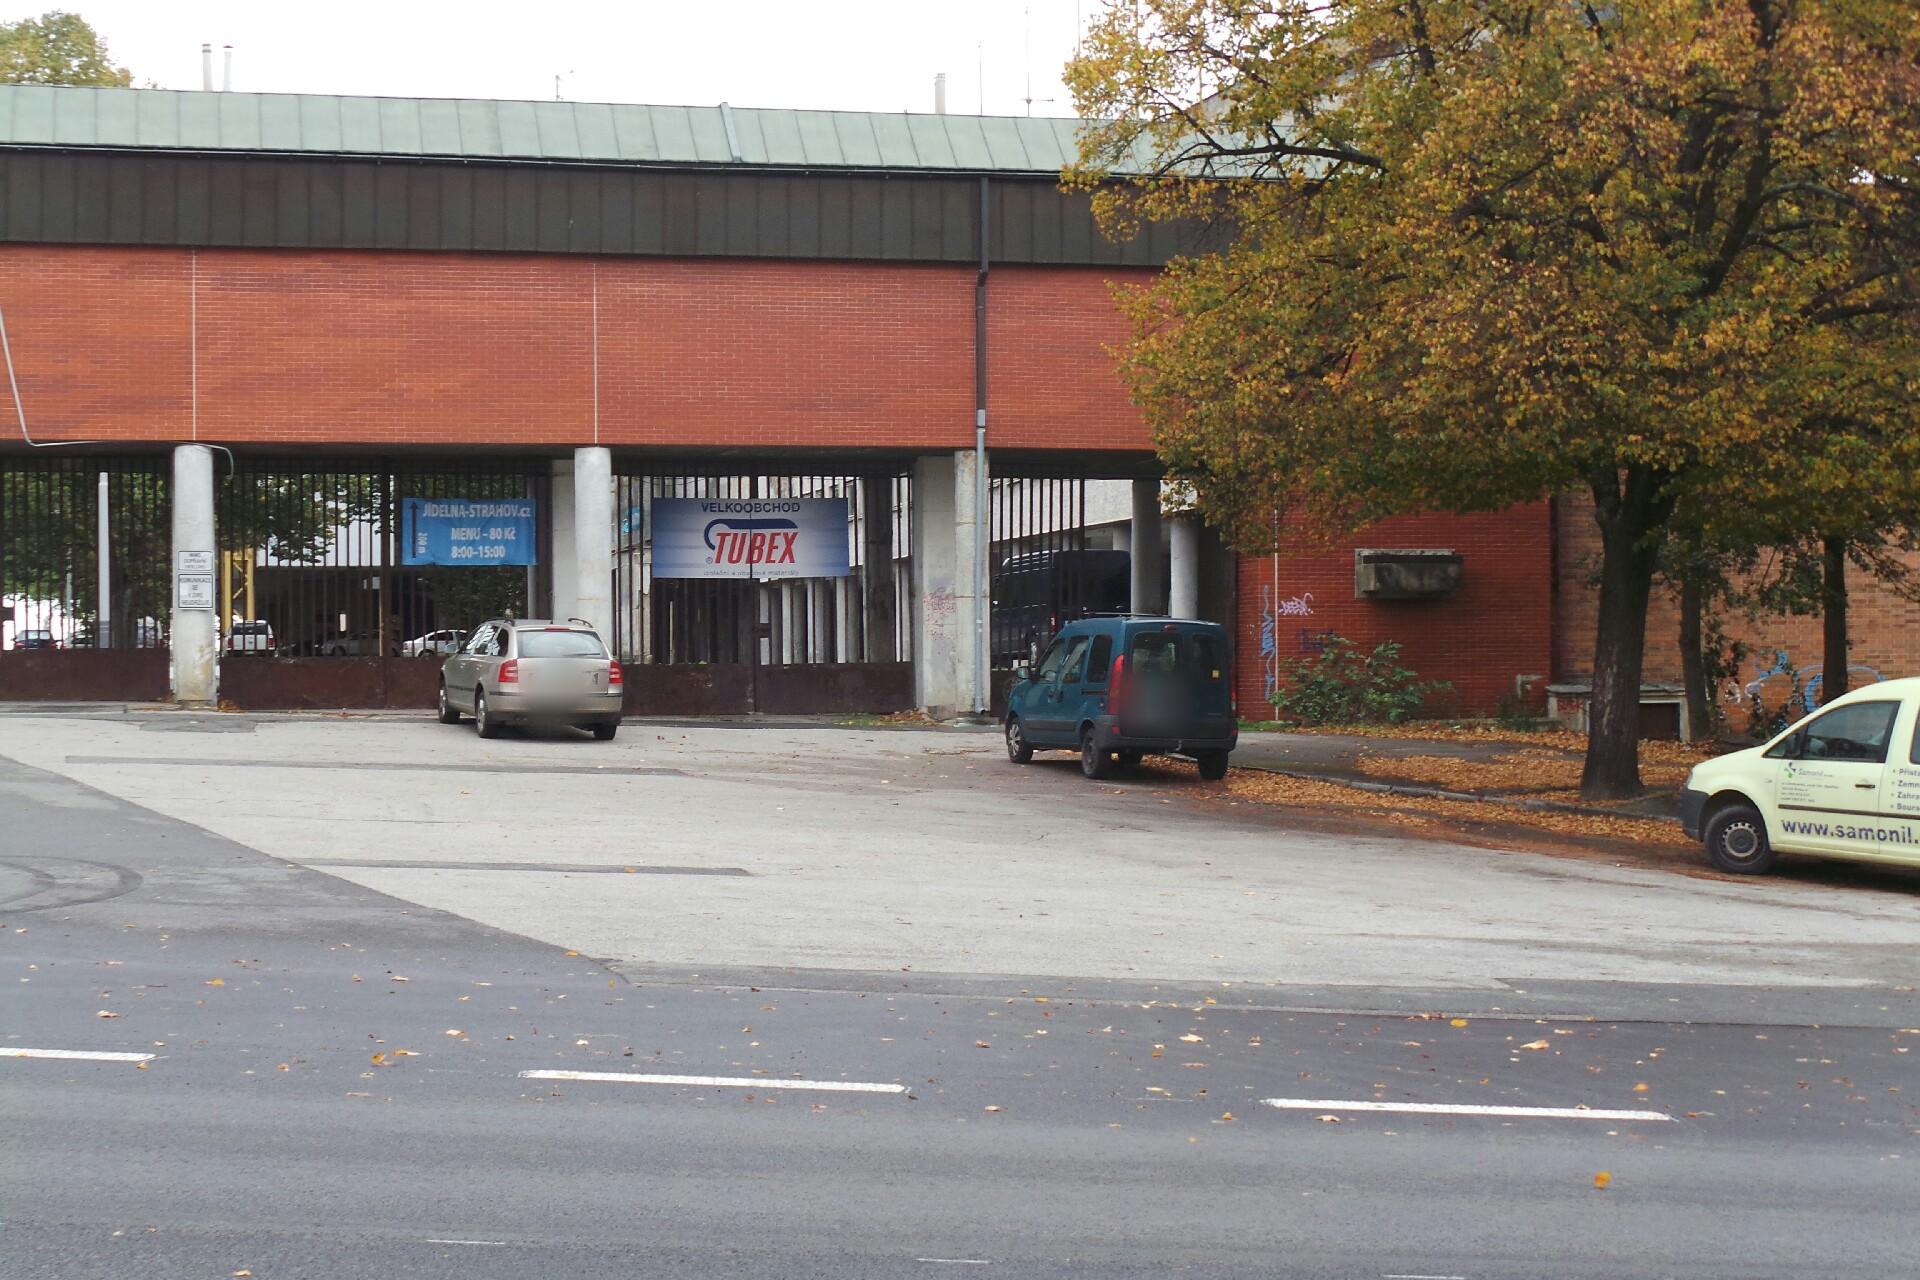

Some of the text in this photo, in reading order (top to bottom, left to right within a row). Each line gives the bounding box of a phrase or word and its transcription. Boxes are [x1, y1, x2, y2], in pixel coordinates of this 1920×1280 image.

[701, 502, 800, 513] VELKOOBCHOD
[451, 528, 480, 540] MENU
[489, 528, 502, 540] 80
[504, 527, 516, 540] Kč
[714, 532, 799, 565] TUBEX
